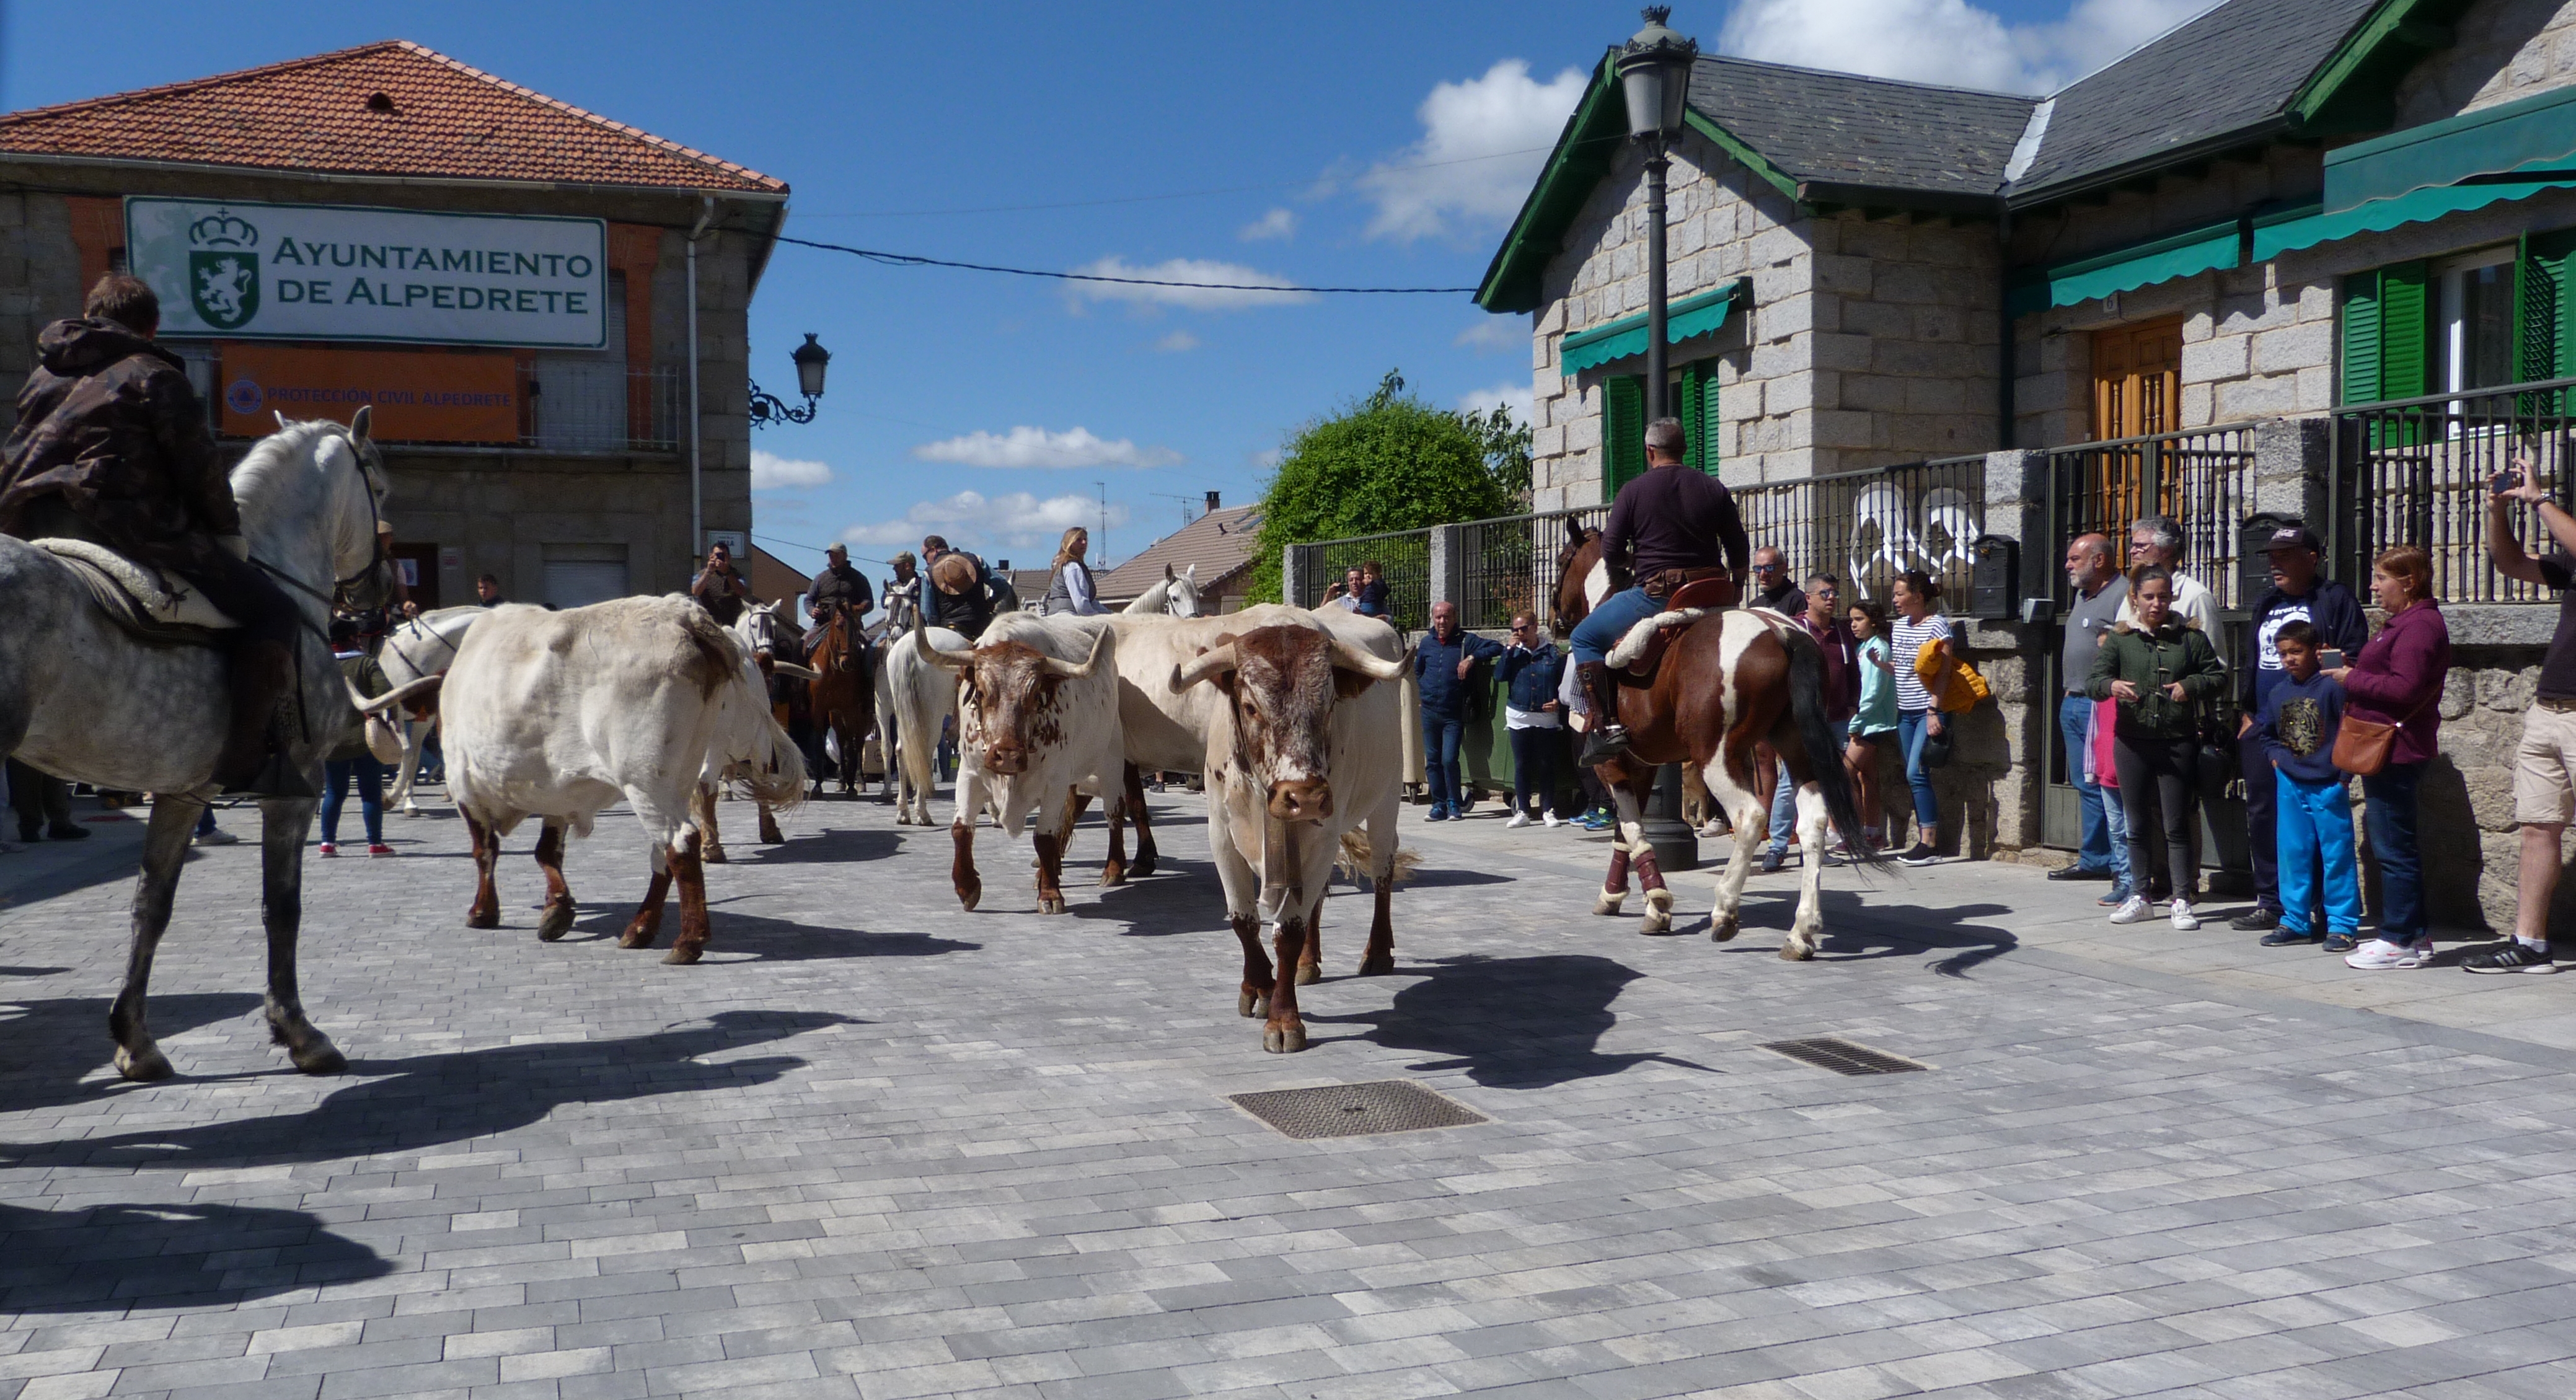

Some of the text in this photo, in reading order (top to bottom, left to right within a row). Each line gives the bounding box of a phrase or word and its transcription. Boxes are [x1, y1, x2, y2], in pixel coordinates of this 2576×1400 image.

[271, 237, 592, 278] AYUNTAMIENTO
[278, 277, 588, 314] DE ALPEDRETE
[268, 387, 371, 402] PROTECCIÓN
[377, 390, 414, 404] CIVIL
[423, 391, 511, 407] ALPEDRETE
